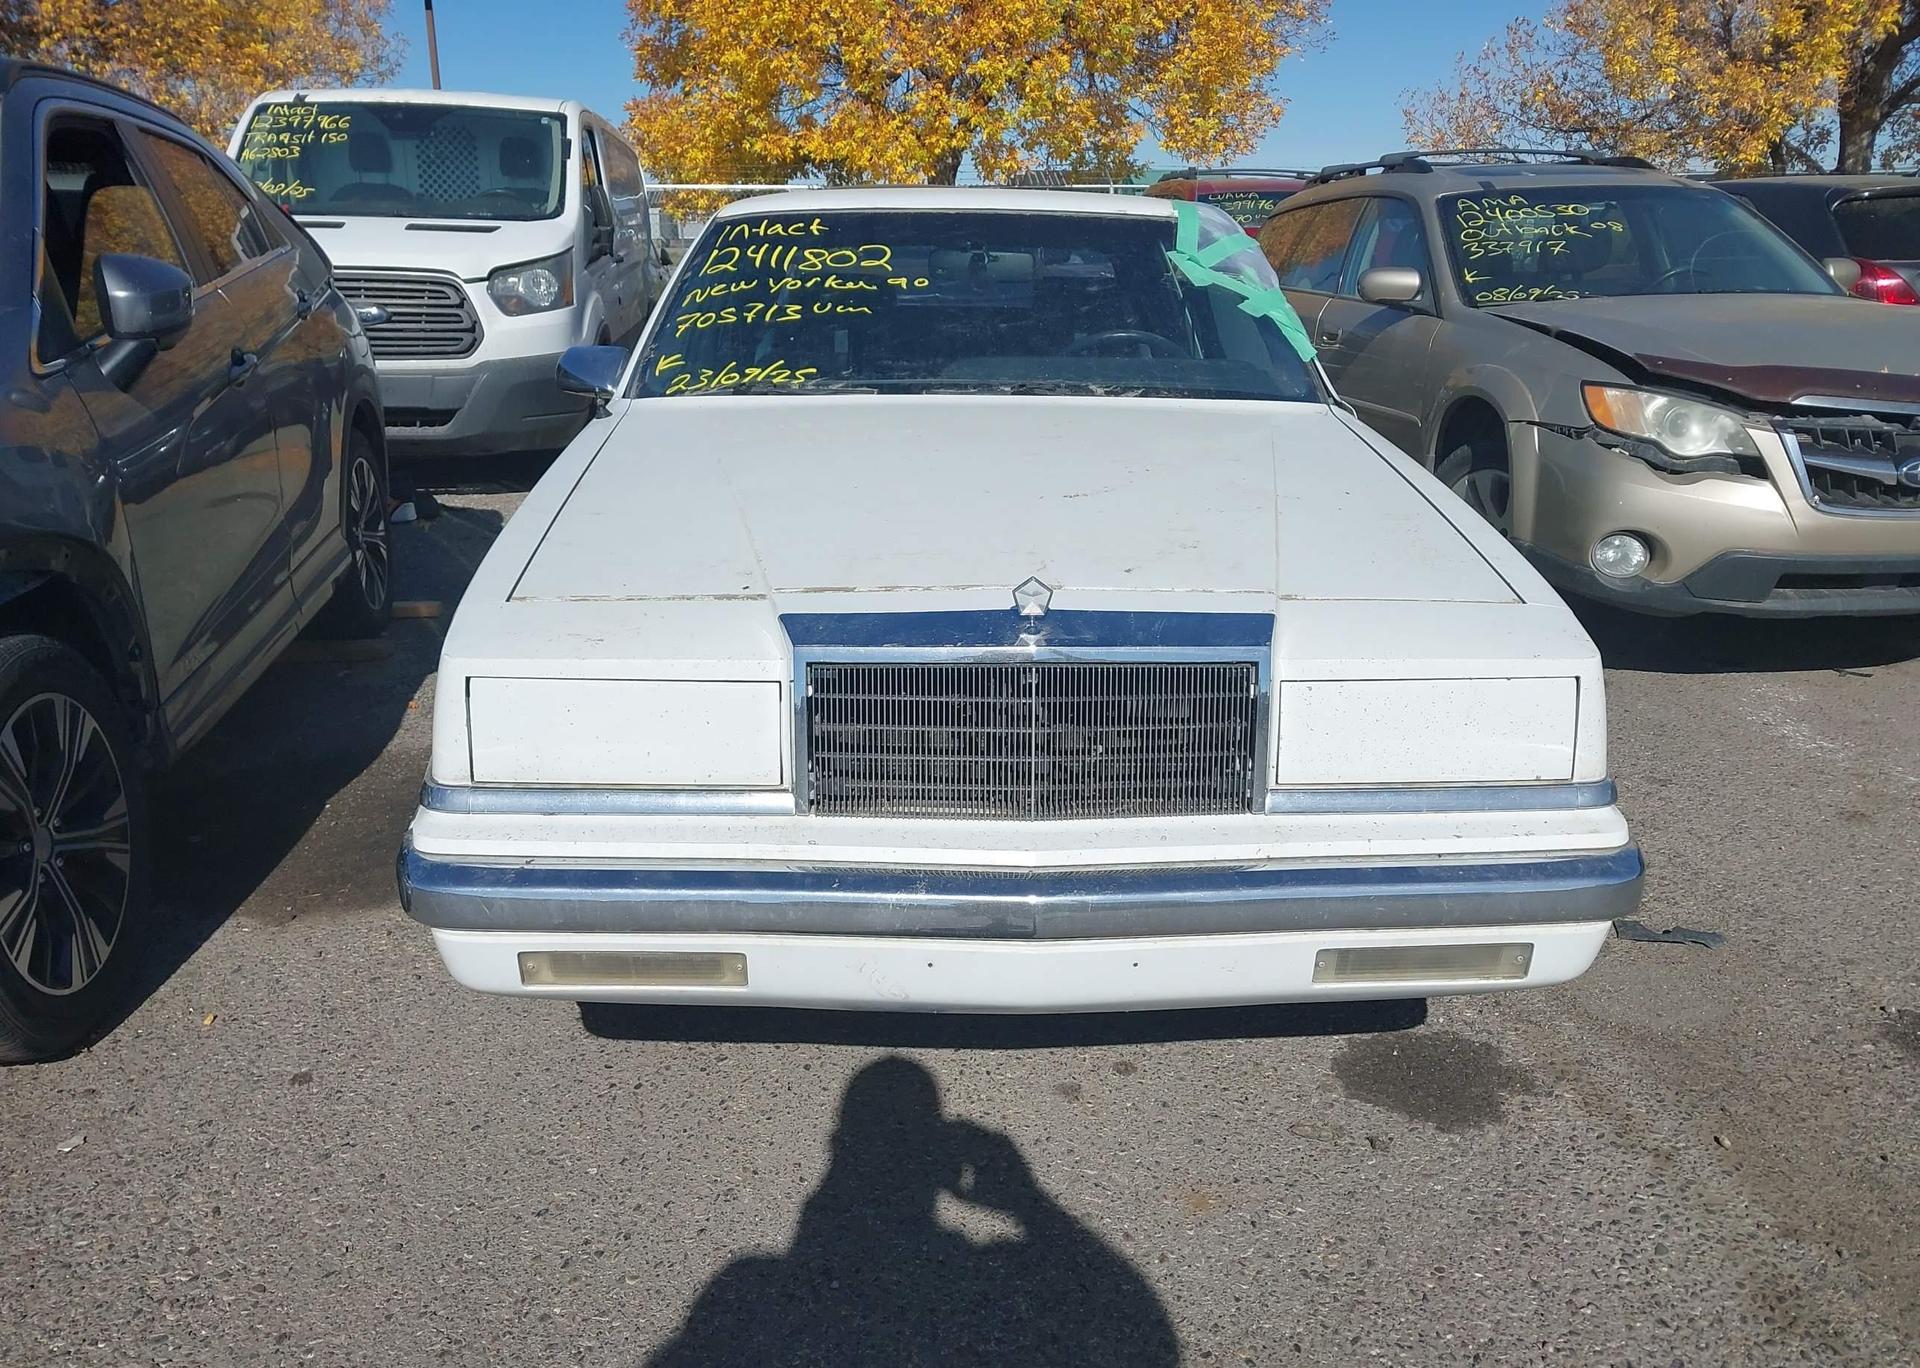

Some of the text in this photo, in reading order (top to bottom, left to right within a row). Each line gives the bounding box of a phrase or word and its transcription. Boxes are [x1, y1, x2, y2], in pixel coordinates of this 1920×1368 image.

[321, 132, 348, 144] 150
[1457, 194, 1529, 211] AMA
[698, 242, 893, 277] 12411802
[675, 303, 803, 338] 705713
